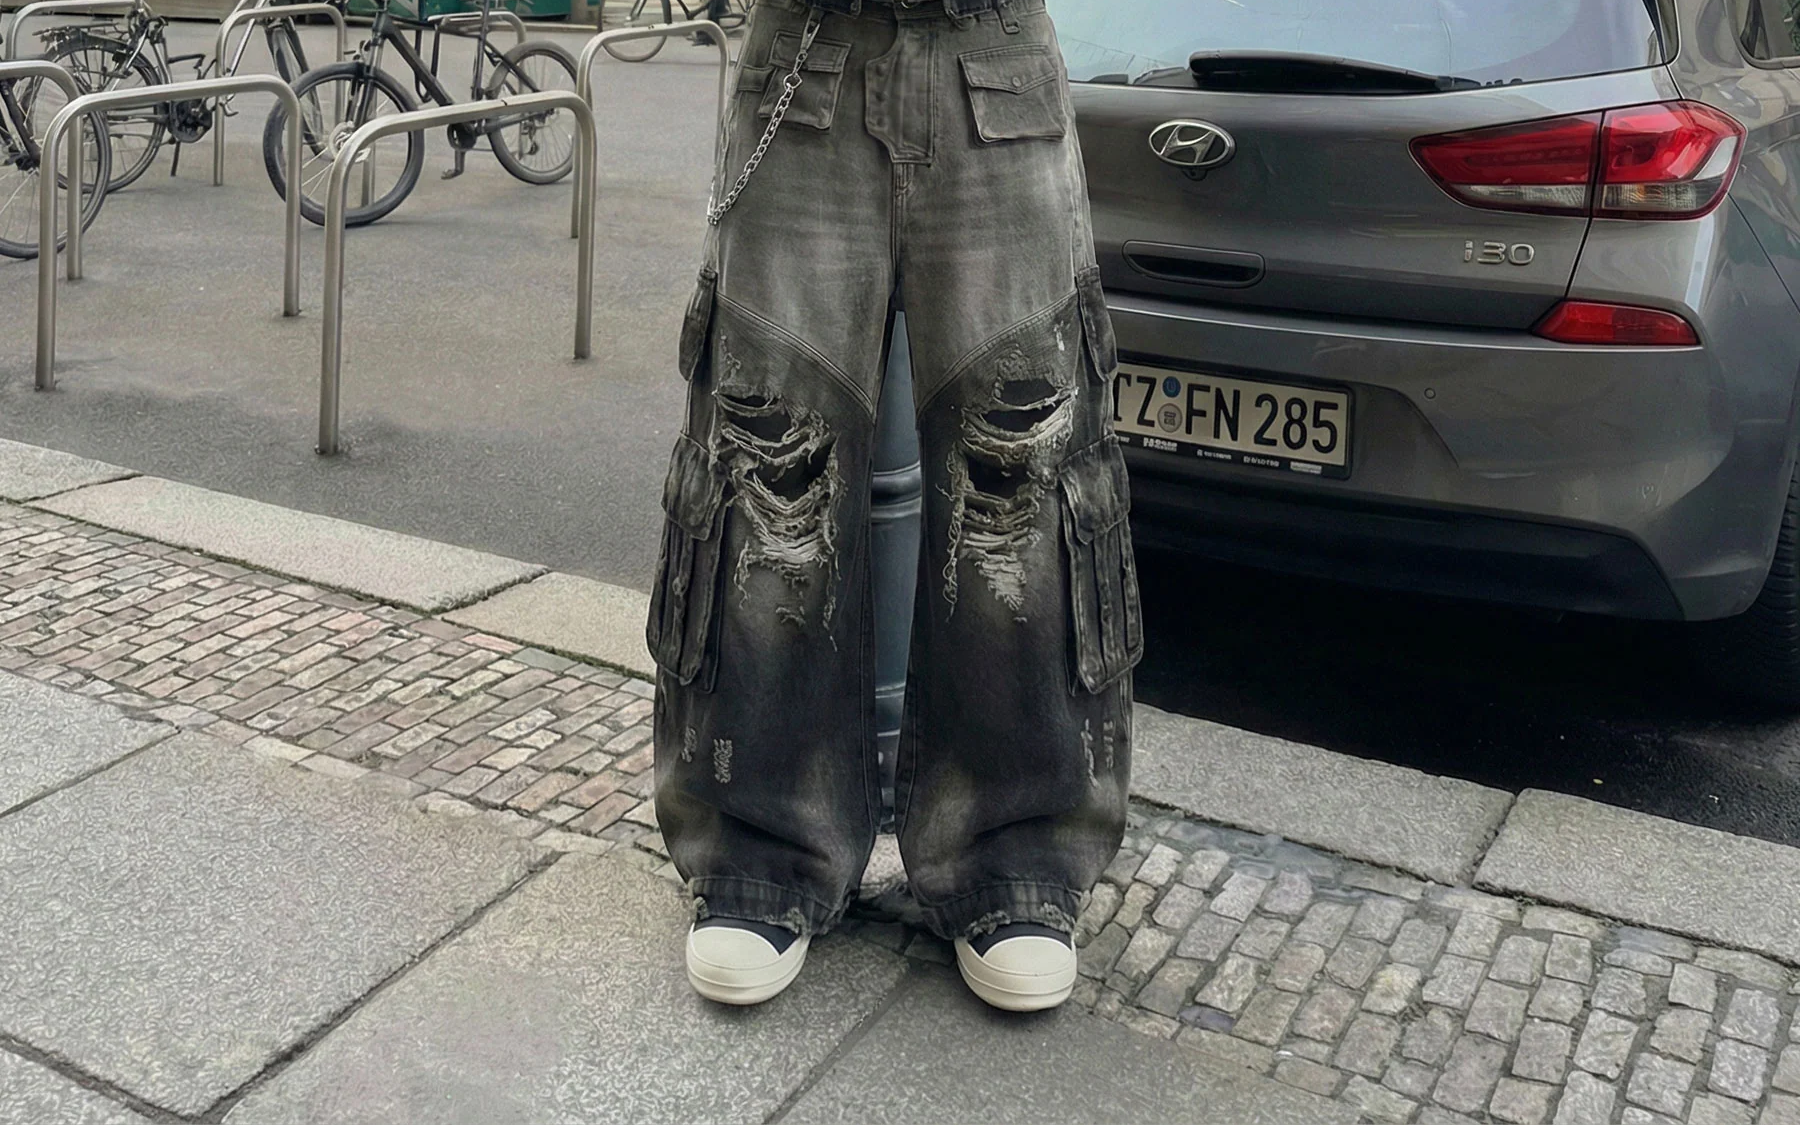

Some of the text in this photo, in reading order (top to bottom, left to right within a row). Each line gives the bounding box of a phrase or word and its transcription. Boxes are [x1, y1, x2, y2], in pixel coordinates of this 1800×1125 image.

[1463, 240, 1535, 266] i30
[1185, 383, 1241, 442] FN
[1254, 393, 1339, 455] 285
